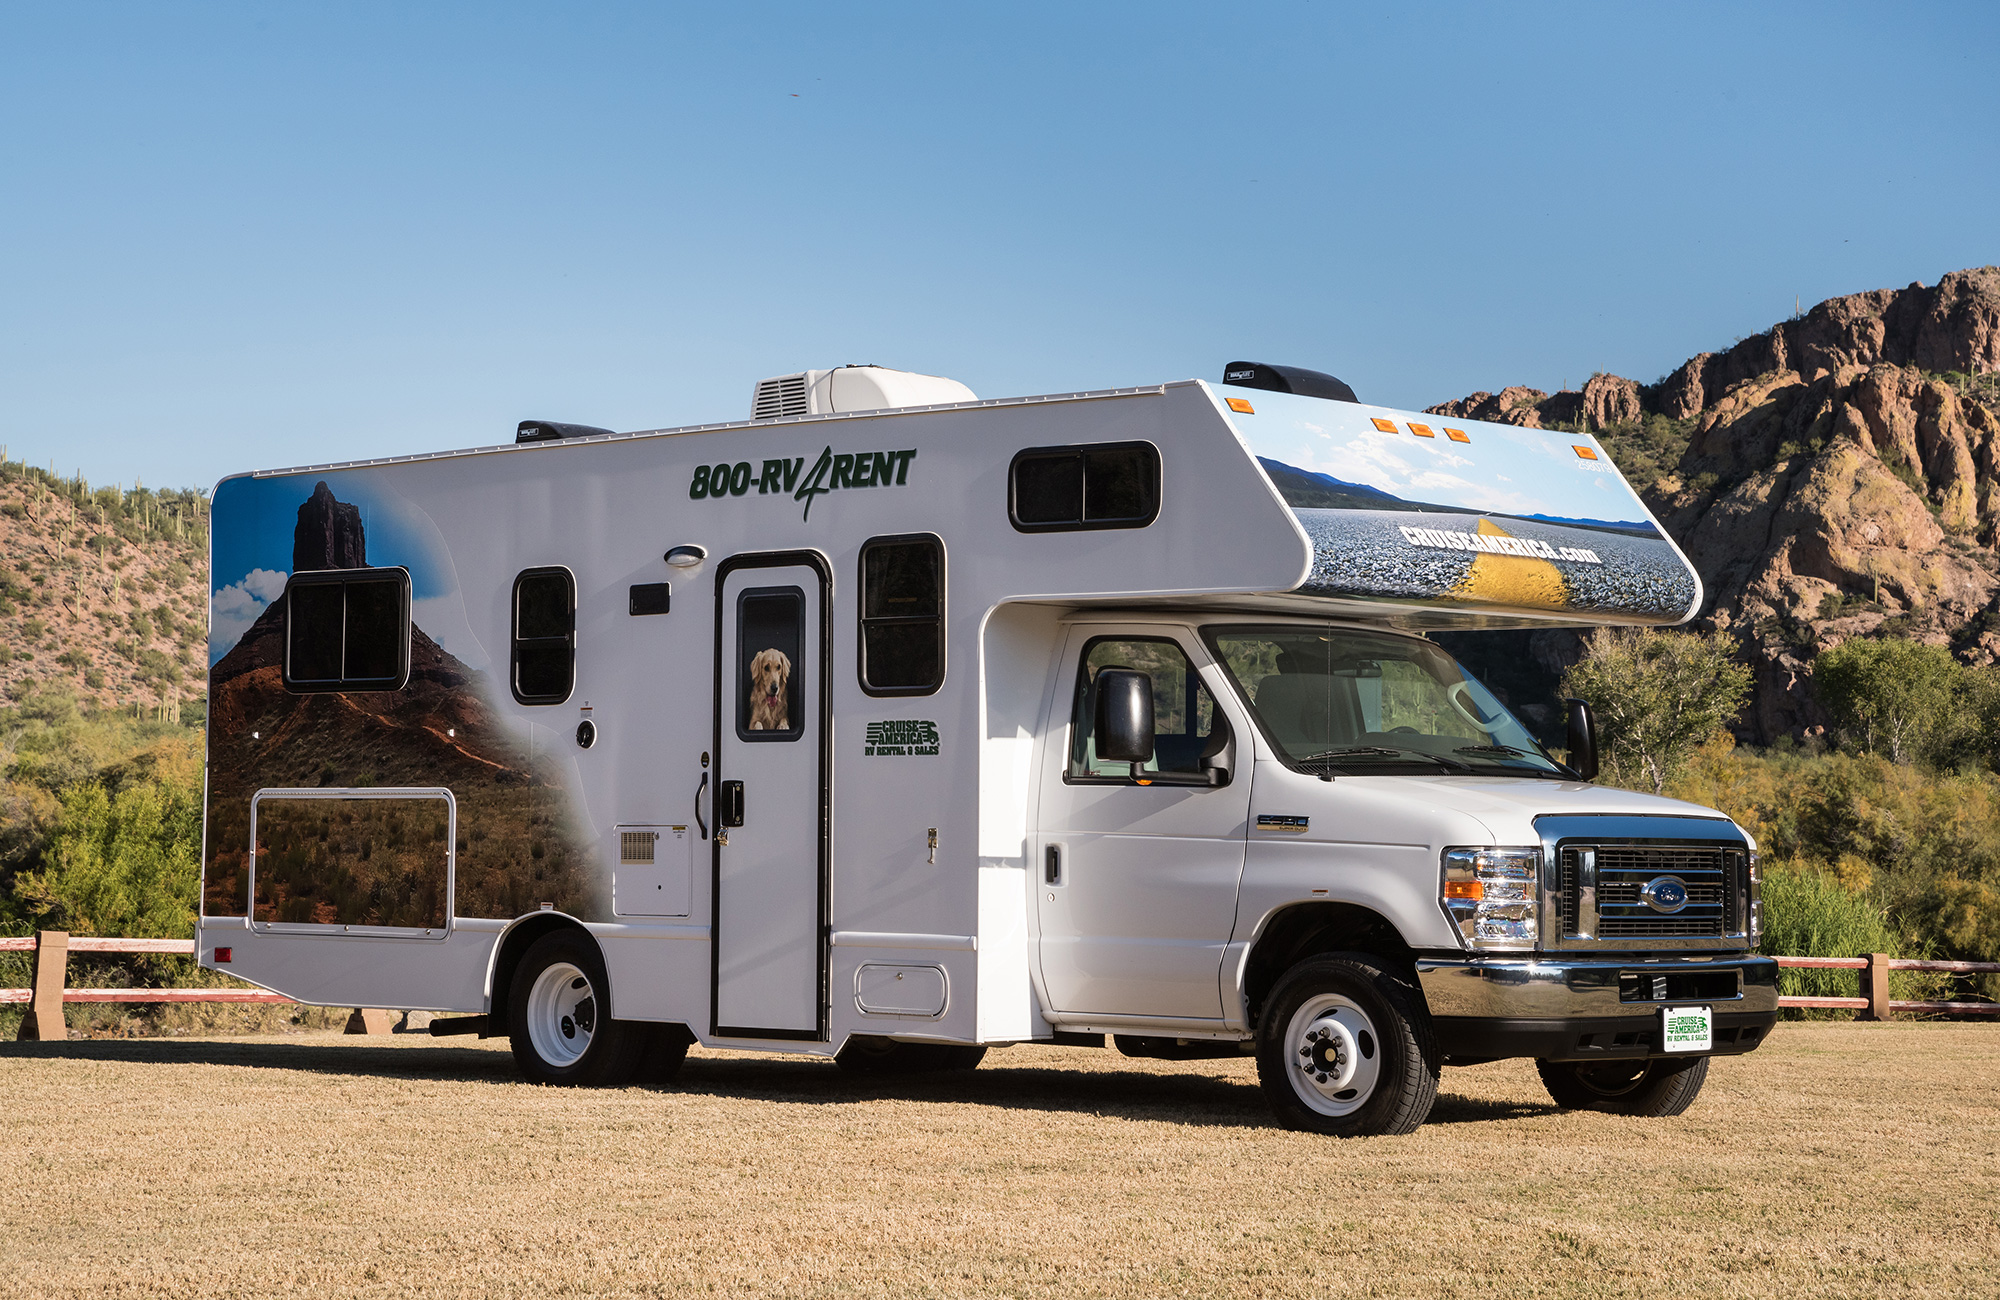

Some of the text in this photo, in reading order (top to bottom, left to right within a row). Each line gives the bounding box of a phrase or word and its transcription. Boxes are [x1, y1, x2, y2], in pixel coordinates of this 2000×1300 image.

[1399, 526, 1602, 564] CRUISEAMERICA.com
[882, 720, 919, 732] CRUISE
[878, 732, 923, 745] AMERICA
[864, 745, 939, 756] RV RENTAL & SALES
[1677, 1016, 1697, 1025] CRUISE
[1674, 1024, 1700, 1034] AMERICA
